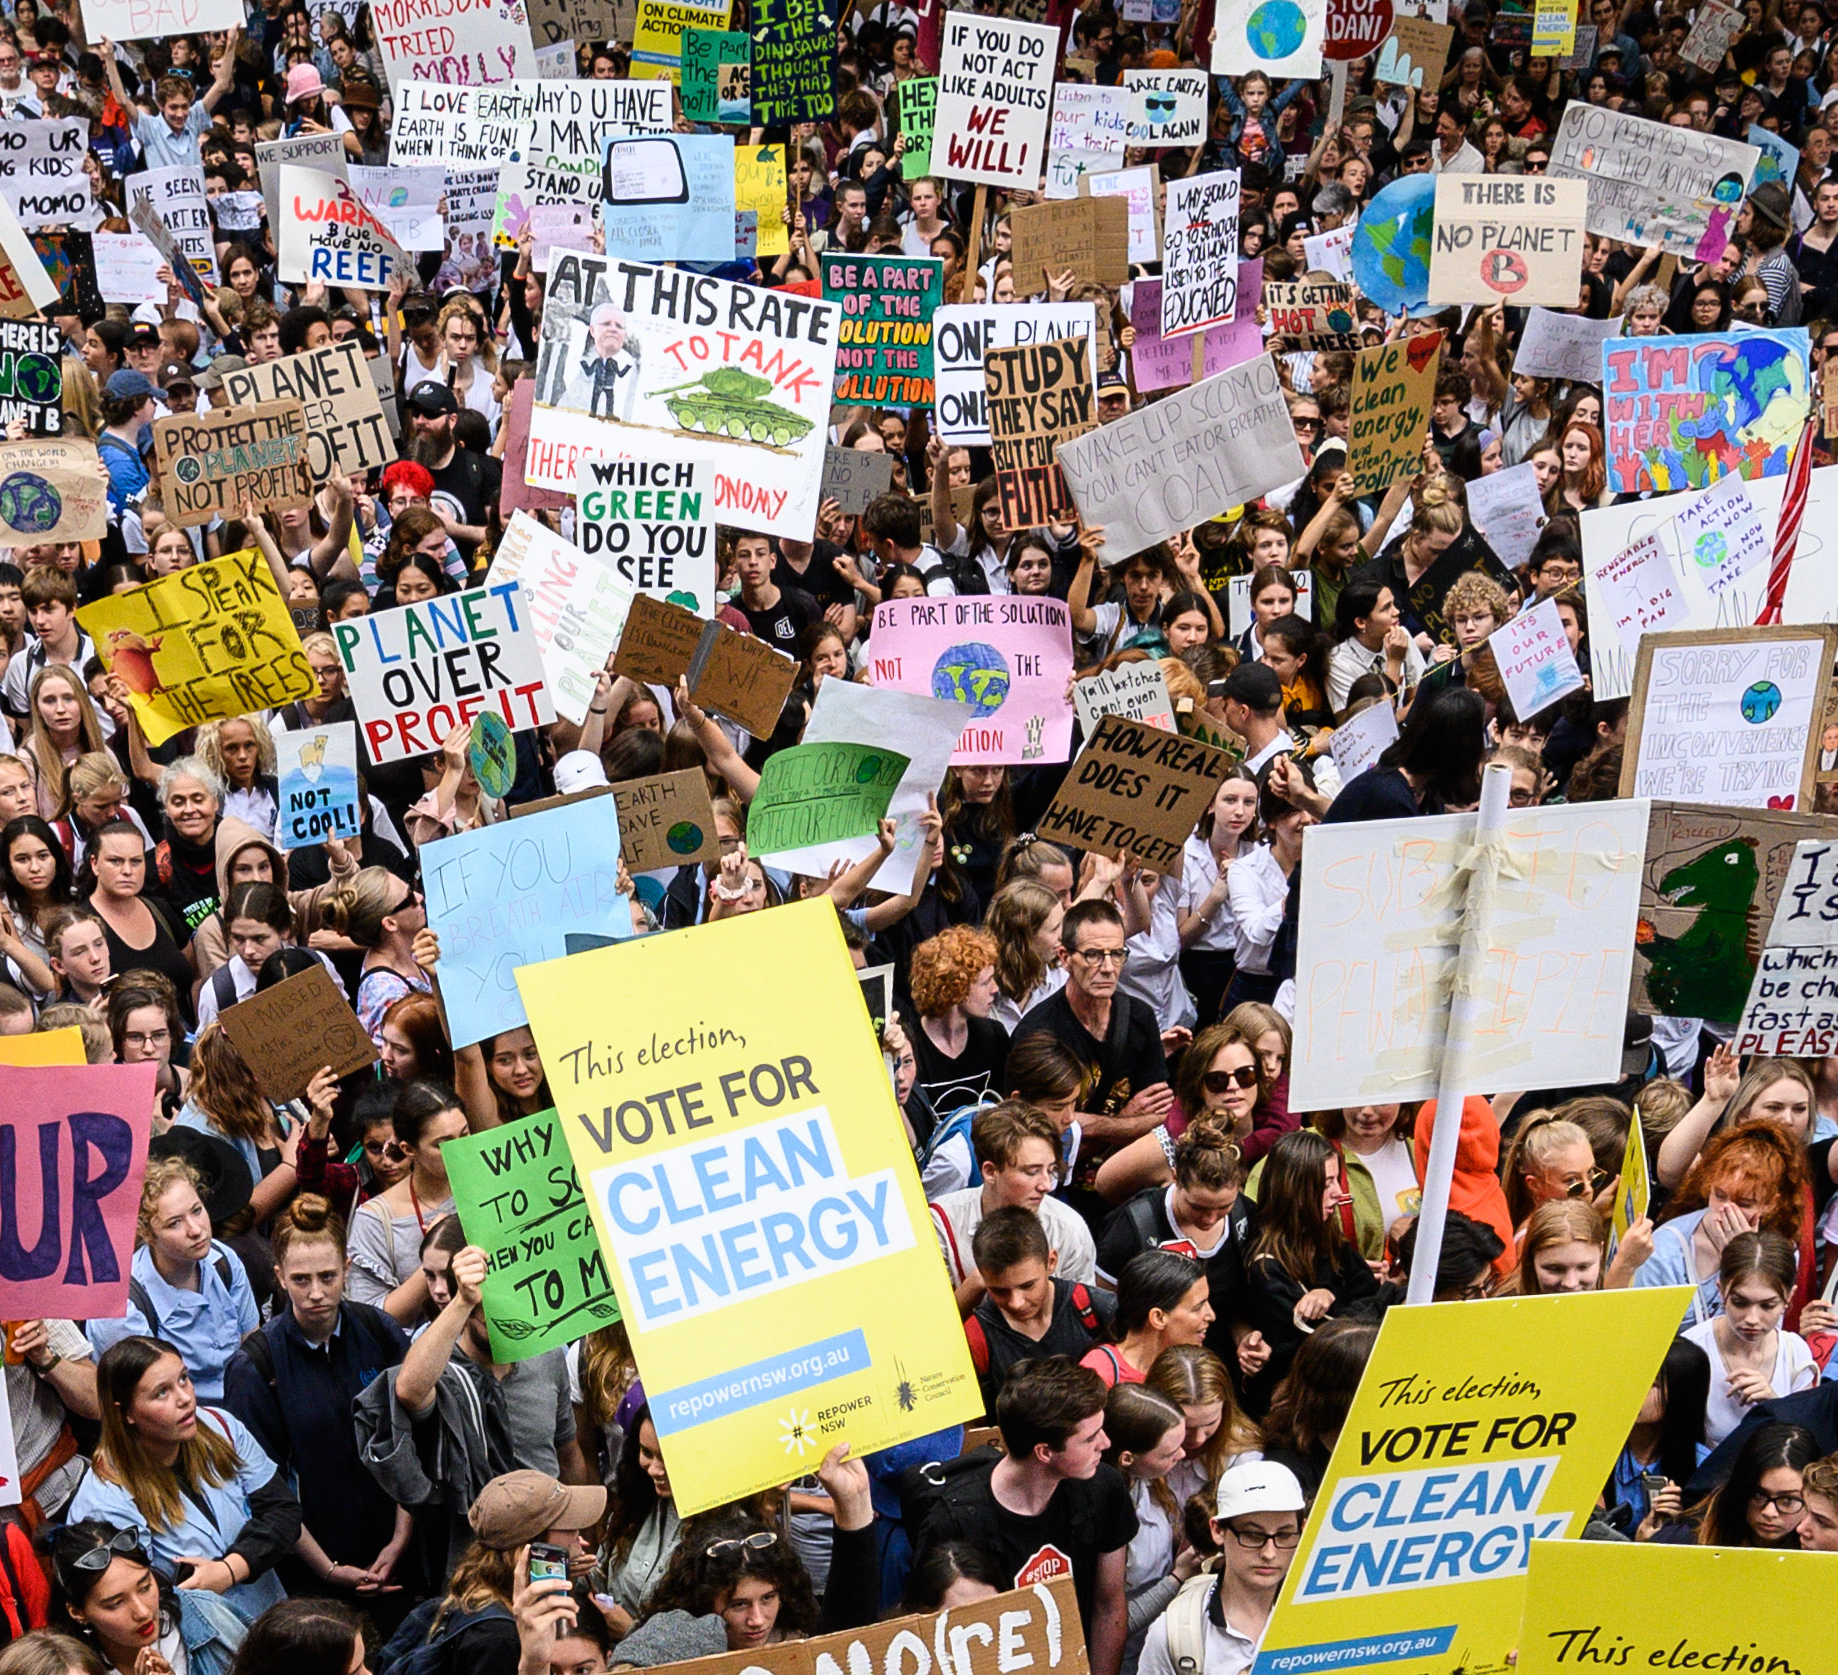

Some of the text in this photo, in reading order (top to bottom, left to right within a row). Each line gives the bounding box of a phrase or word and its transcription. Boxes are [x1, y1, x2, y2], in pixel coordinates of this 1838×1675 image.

[951, 26, 1044, 57] IF YOU DO
[962, 53, 1038, 80] NOT ACT
[942, 75, 1046, 109] LIKE ADULTS
[967, 105, 1010, 135] WE
[948, 133, 1028, 175] WILL!
[1463, 182, 1555, 205] THERE IS
[1437, 223, 1575, 254] NO PLANET
[1491, 255, 1525, 284] B
[549, 256, 832, 345] AT THIS RATE
[31, 325, 59, 354] IS
[45, 407, 60, 432] B
[590, 463, 695, 488] WHICH
[582, 490, 702, 522] GREEN
[583, 523, 707, 558] DO YOU
[617, 555, 674, 588] SEE
